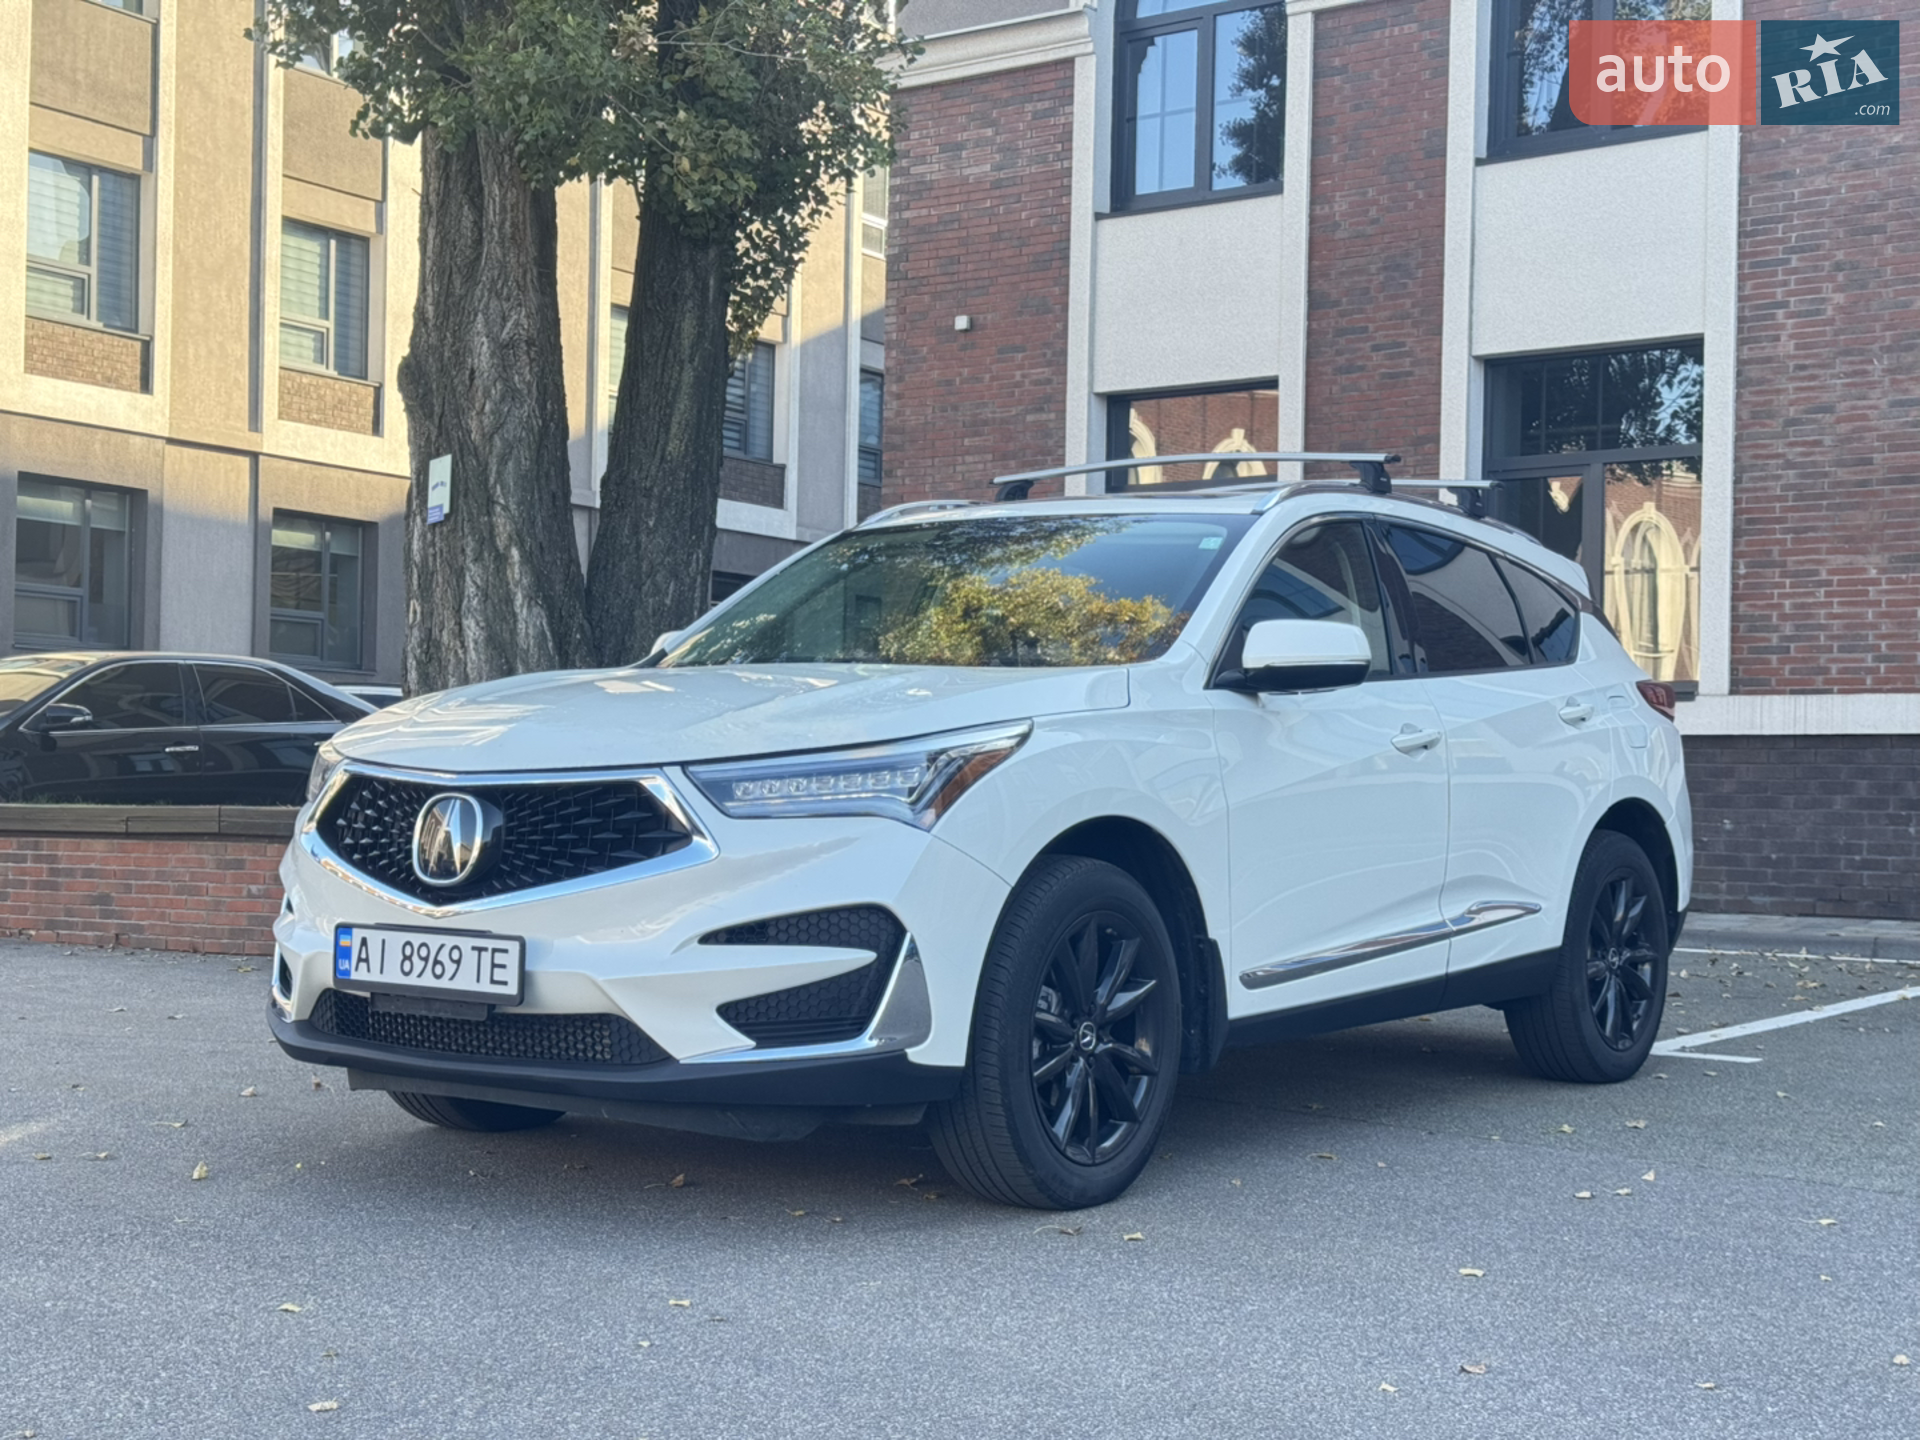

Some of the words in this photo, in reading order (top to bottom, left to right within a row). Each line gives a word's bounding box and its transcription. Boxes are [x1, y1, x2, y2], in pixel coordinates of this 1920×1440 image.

[338, 959, 350, 970] UA
[354, 936, 386, 975] AI
[400, 940, 463, 981] 8969
[471, 946, 509, 986] TE
